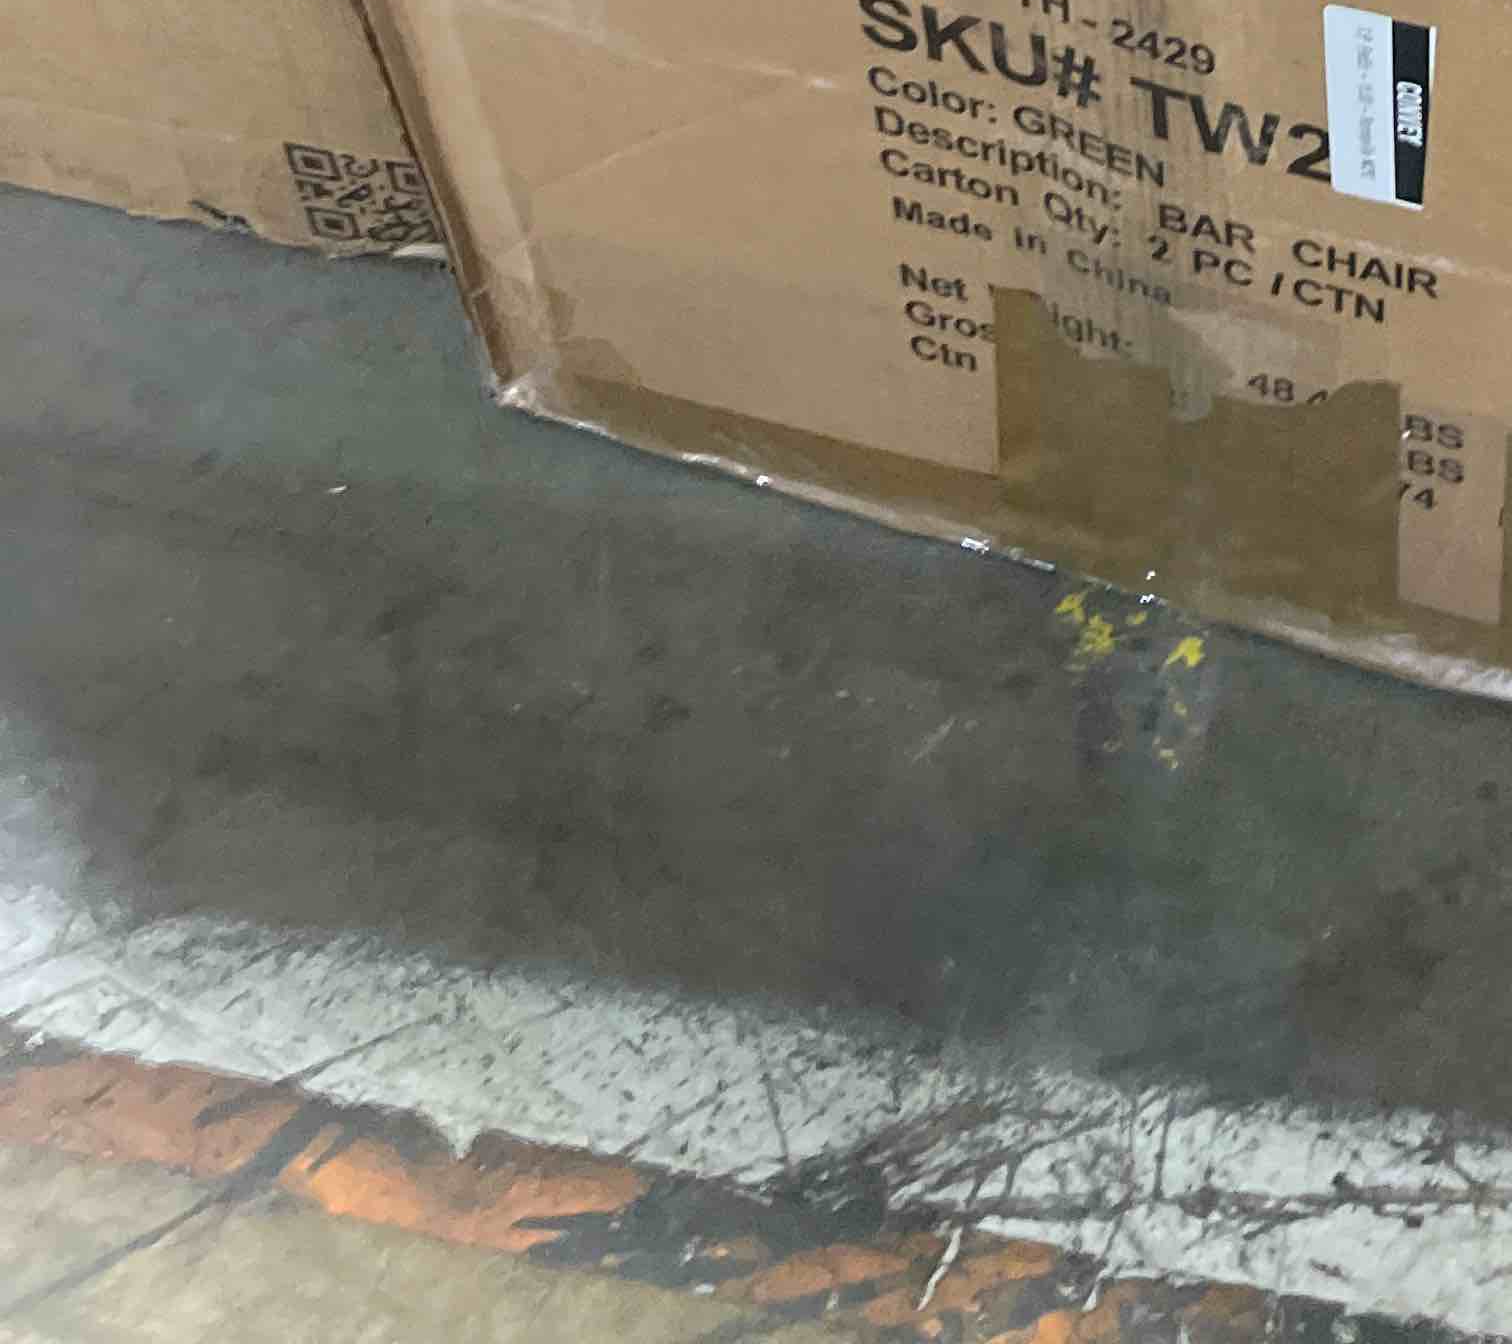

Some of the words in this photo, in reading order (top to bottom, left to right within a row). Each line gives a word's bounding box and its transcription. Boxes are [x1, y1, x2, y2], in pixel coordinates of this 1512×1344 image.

[867, 66, 998, 125] Color:
[1012, 106, 1166, 188] GREEN
[873, 107, 1123, 212] Description:
[1158, 202, 1256, 253] BAR
[1291, 238, 1440, 300] CHAIR
[880, 147, 1019, 208] Carton
[1042, 189, 1121, 249] Qty:
[1149, 235, 1172, 264] 2
[1192, 249, 1253, 287] PC
[891, 195, 994, 244] Made
[1066, 243, 1173, 306] China
[899, 263, 969, 303] Net
[1402, 412, 1466, 450] BS
[1403, 448, 1467, 485] BS
